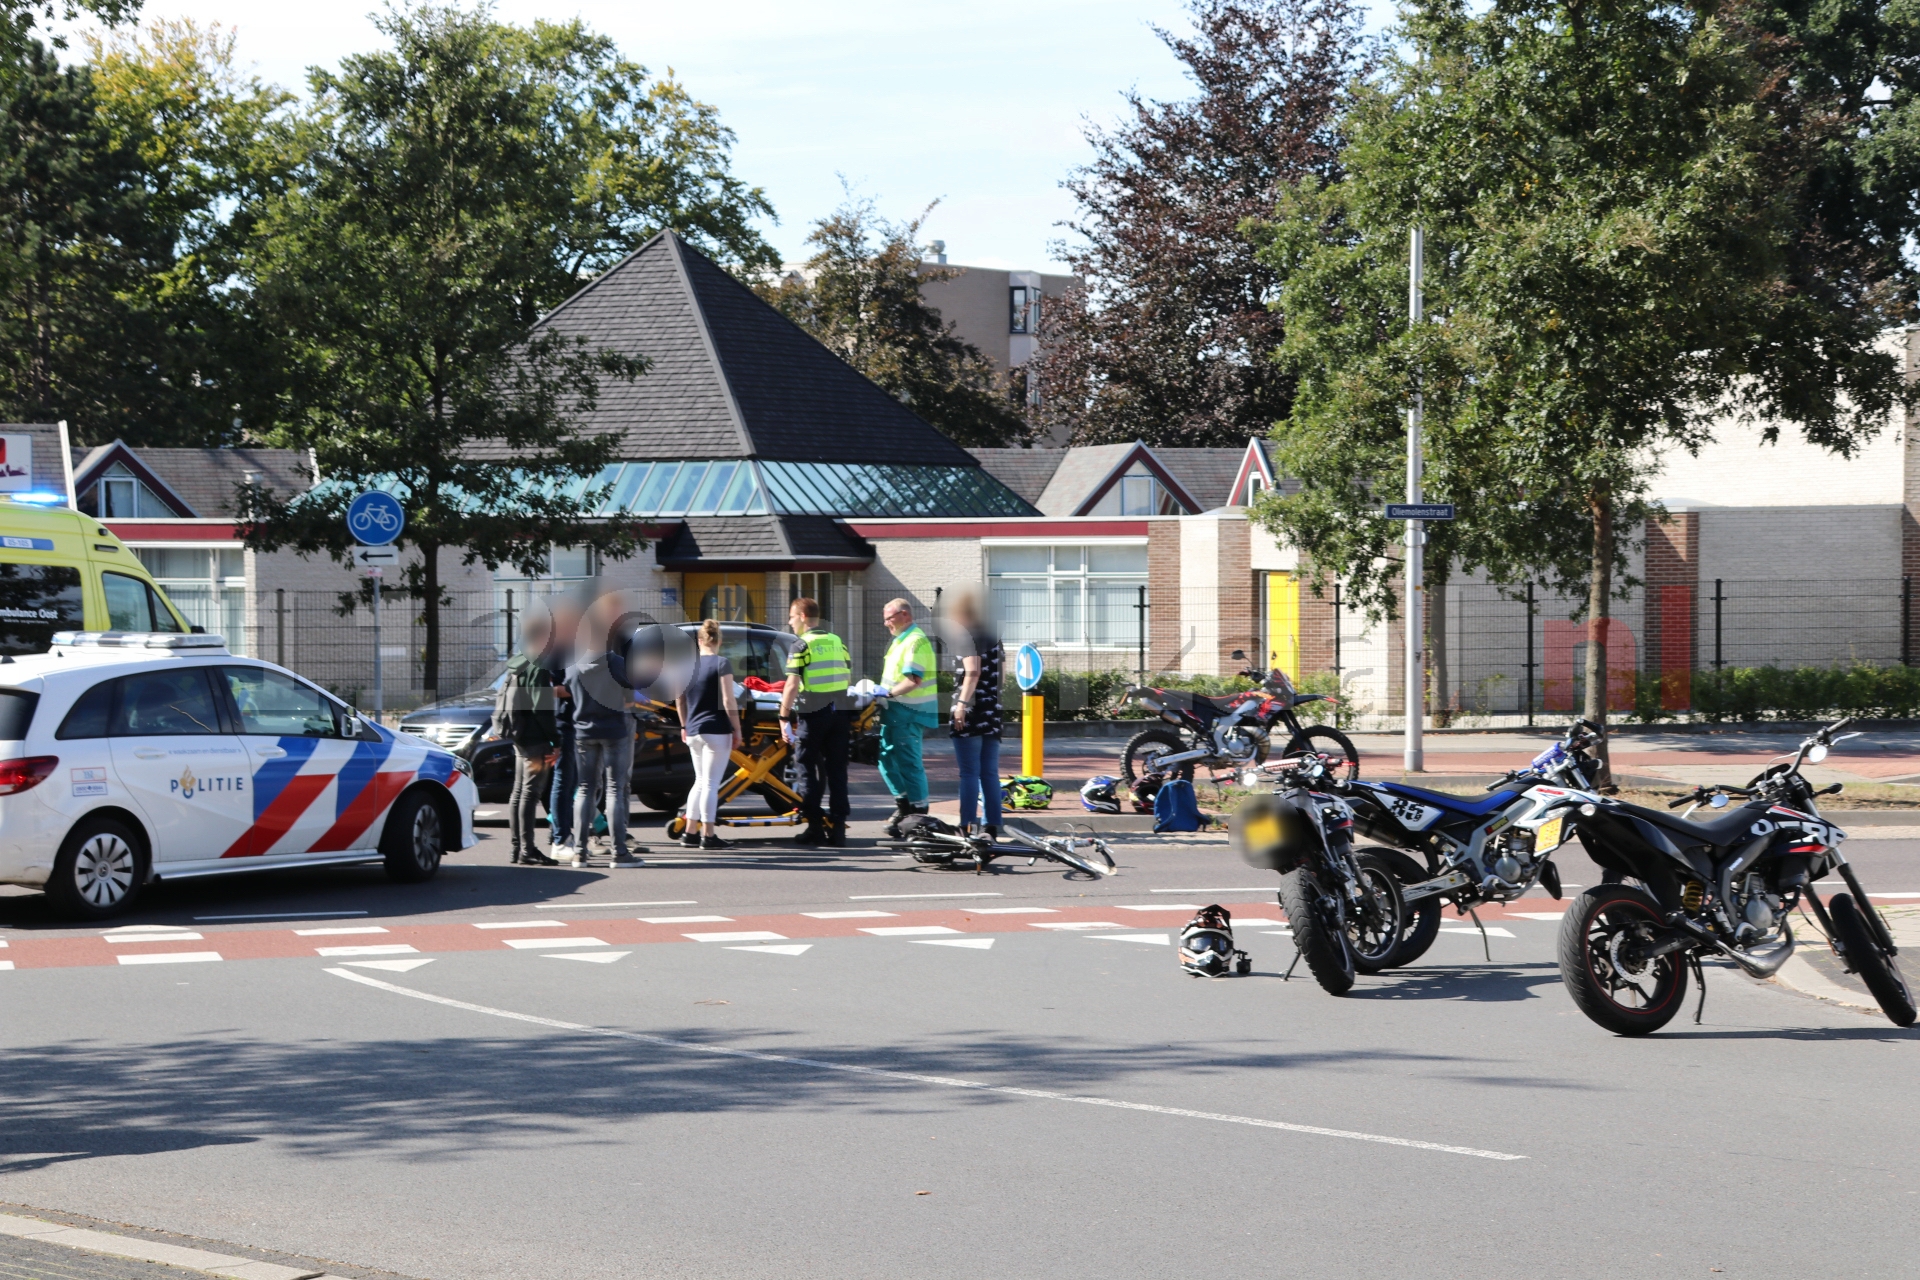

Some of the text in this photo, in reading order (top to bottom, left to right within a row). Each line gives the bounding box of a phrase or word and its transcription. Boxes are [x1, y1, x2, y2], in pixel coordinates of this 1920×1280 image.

[1391, 507, 1449, 516] Oliemolenstraat
[0, 606, 59, 619] mbulance Oost
[171, 777, 244, 799] POLITIE
[1391, 797, 1425, 822] 85
